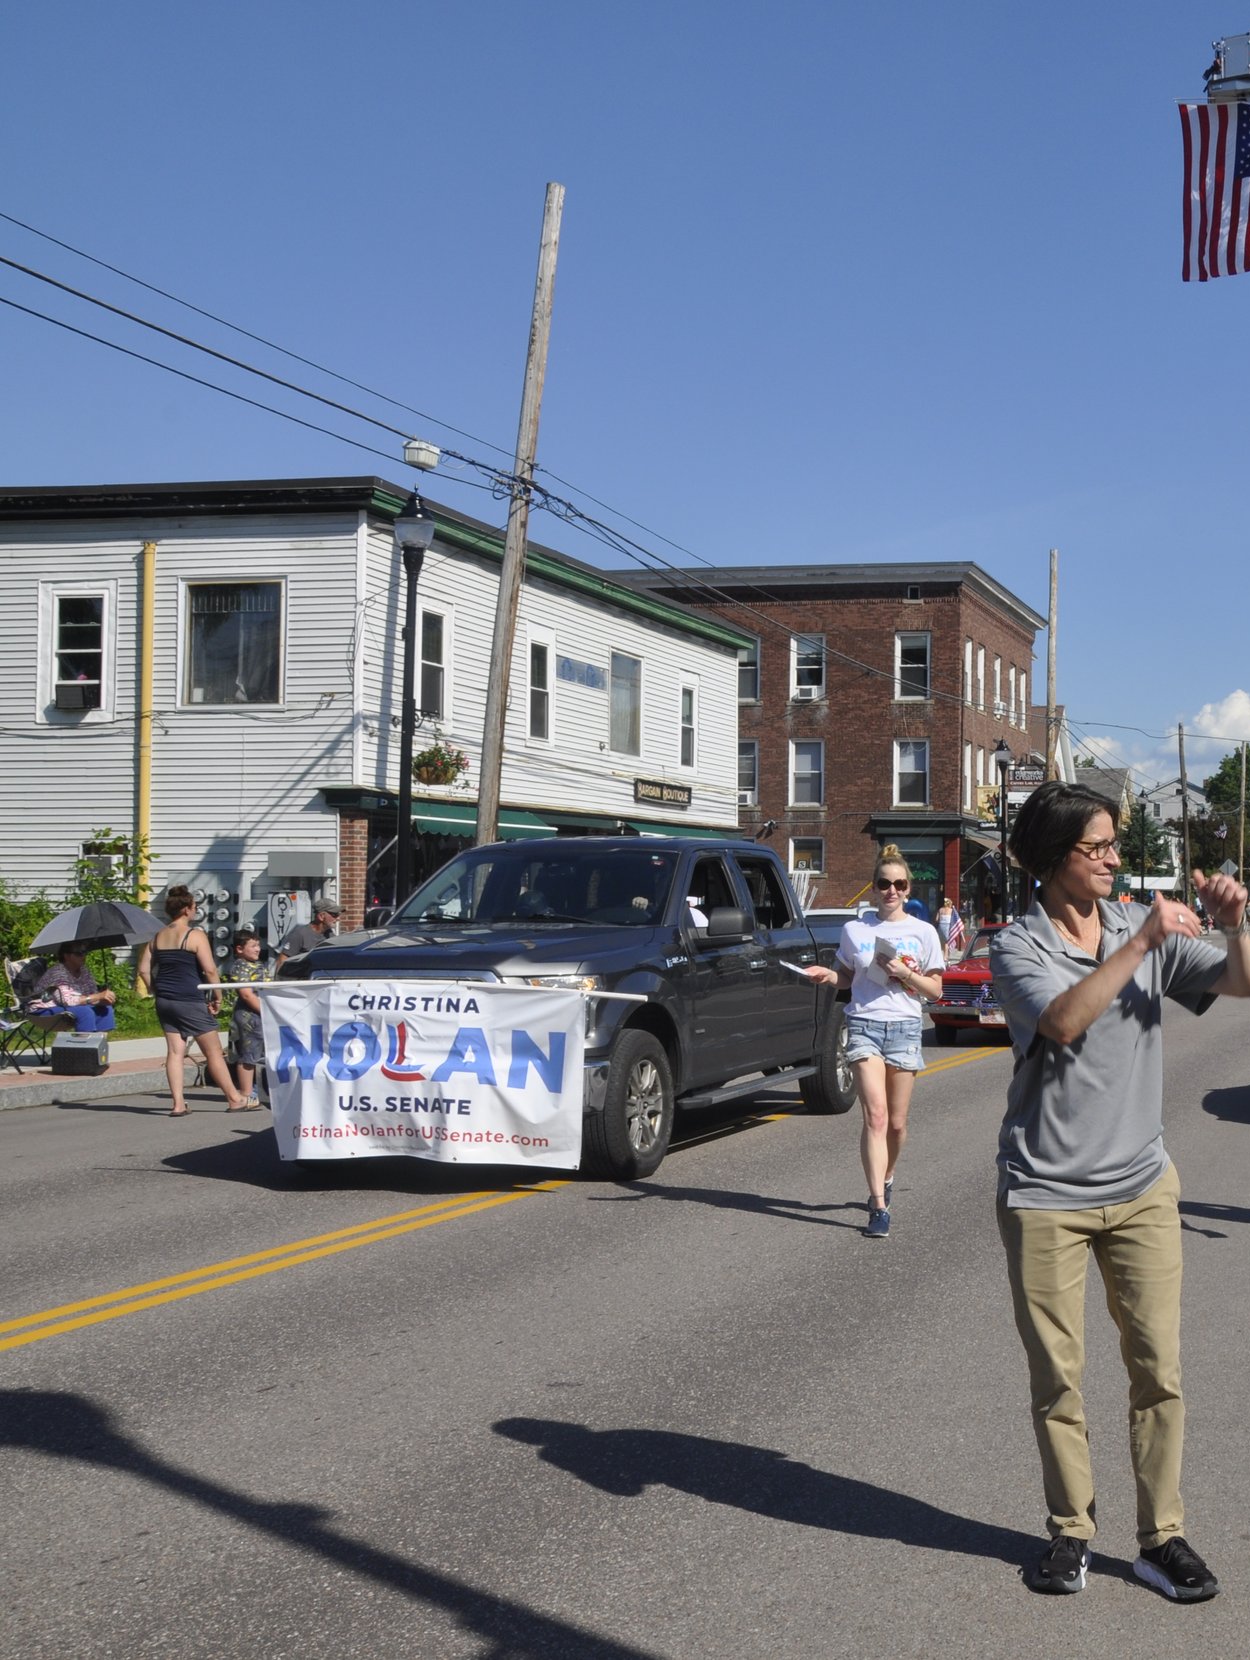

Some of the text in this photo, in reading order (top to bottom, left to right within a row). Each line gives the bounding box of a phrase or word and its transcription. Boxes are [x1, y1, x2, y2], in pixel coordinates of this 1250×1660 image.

[637, 781, 689, 803] BARGAIN BOUTIQUE
[860, 941, 918, 953] NAN
[348, 994, 480, 1014] CHRISTINA
[276, 1020, 567, 1094] NOLAN
[338, 1095, 471, 1115] U.S. SENATE
